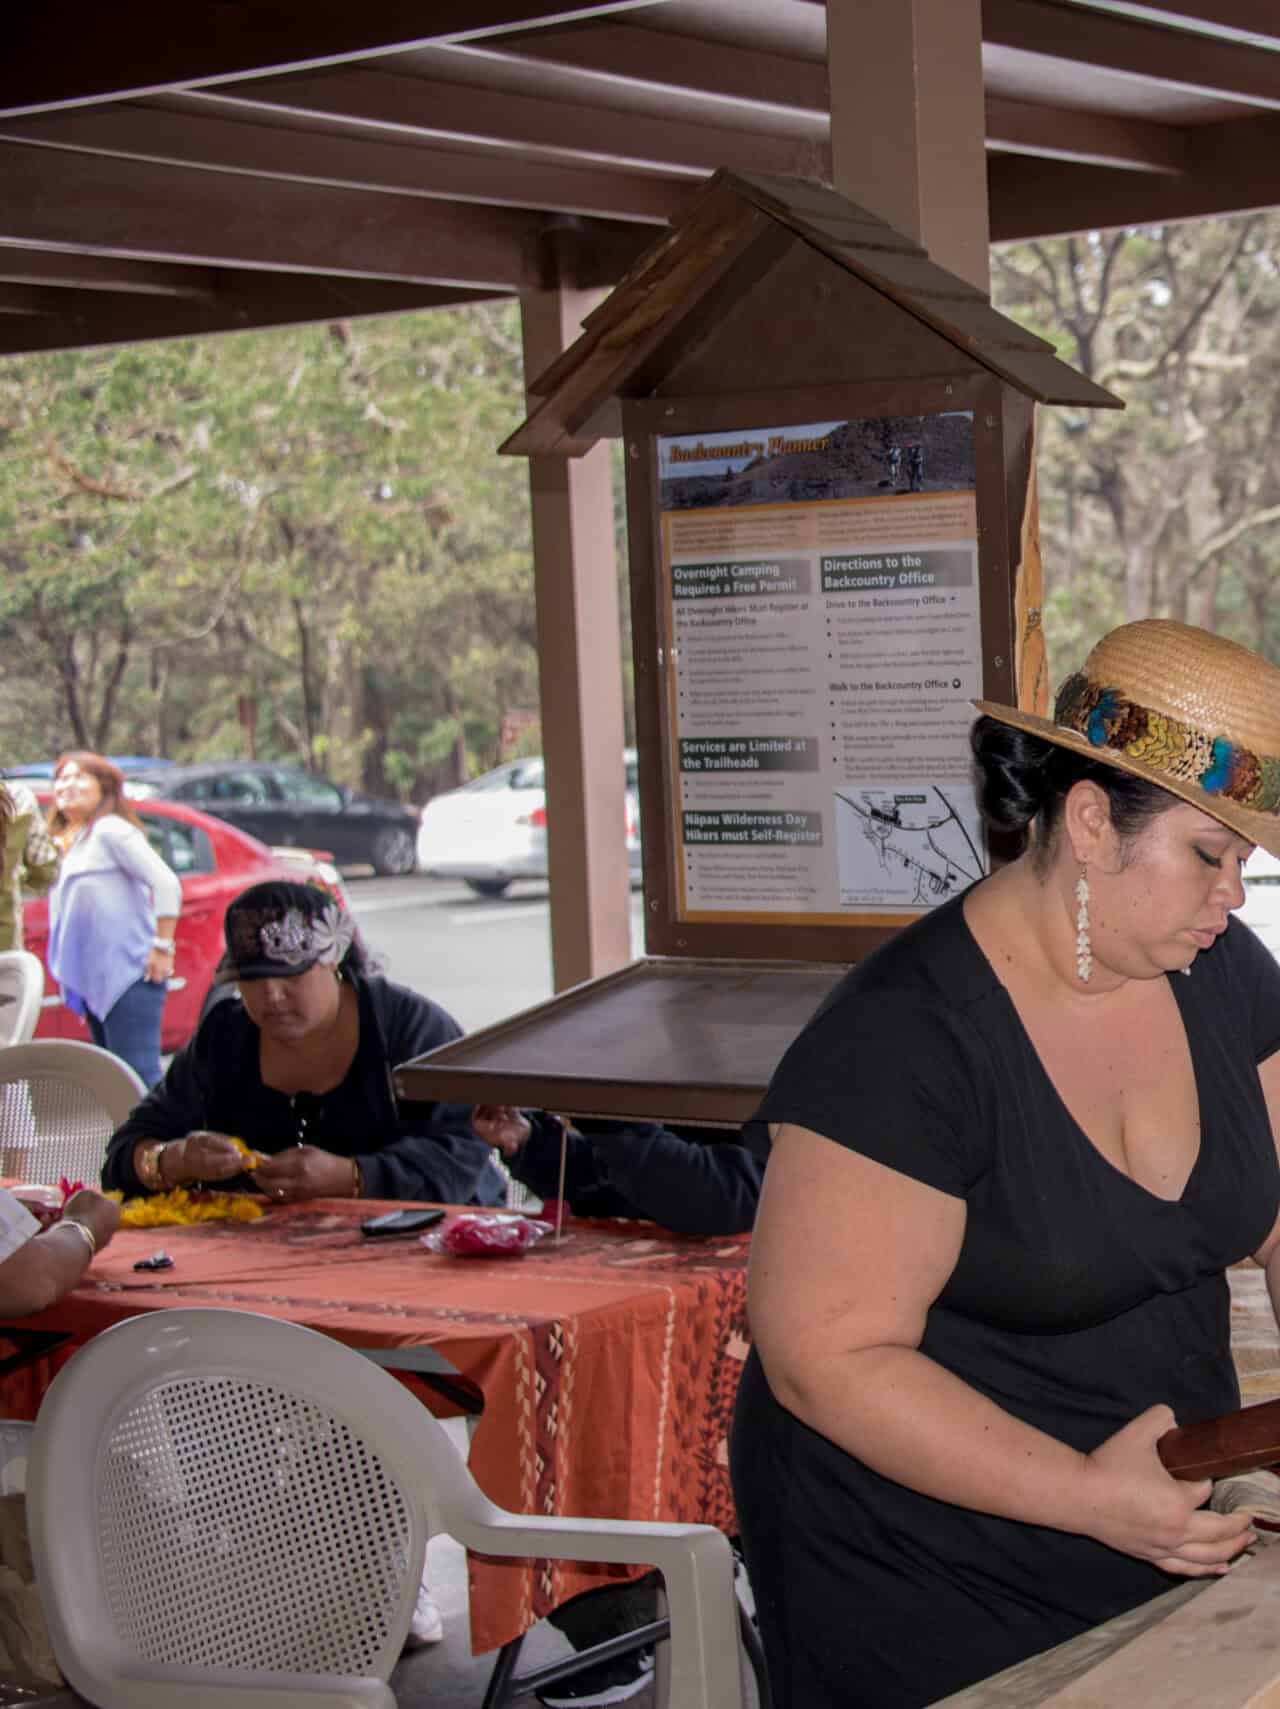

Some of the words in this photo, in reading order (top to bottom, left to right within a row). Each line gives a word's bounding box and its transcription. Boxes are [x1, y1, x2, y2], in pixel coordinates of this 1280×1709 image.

[670, 440, 765, 464] Backcountry
[768, 435, 830, 457] Planner
[824, 558, 882, 571] Directions
[886, 558, 898, 569] to
[901, 555, 922, 568] the
[674, 566, 728, 581] Overnight
[731, 565, 780, 580] Camping
[824, 575, 896, 588] Backcountry
[898, 571, 935, 585] Office
[675, 583, 721, 598] Requires
[724, 585, 731, 594] a
[734, 581, 756, 593] Free
[759, 578, 798, 592] Permit
[848, 600, 857, 609] to
[858, 599, 871, 608] the
[872, 597, 920, 610] Backcountry
[921, 595, 946, 605] Office
[850, 681, 859, 690] to
[860, 680, 873, 690] the
[875, 679, 922, 692] Backcountry
[924, 678, 949, 689] Office
[683, 740, 725, 753] Services
[729, 742, 746, 752] are
[750, 739, 792, 752] Limited
[793, 740, 807, 751] at
[683, 757, 701, 769] the
[704, 756, 759, 769] Trailheads
[721, 813, 783, 825] Wilderness
[786, 813, 808, 828] Day
[686, 830, 719, 841] Hikers
[722, 830, 749, 841] must
[752, 829, 821, 843] Self-Register
